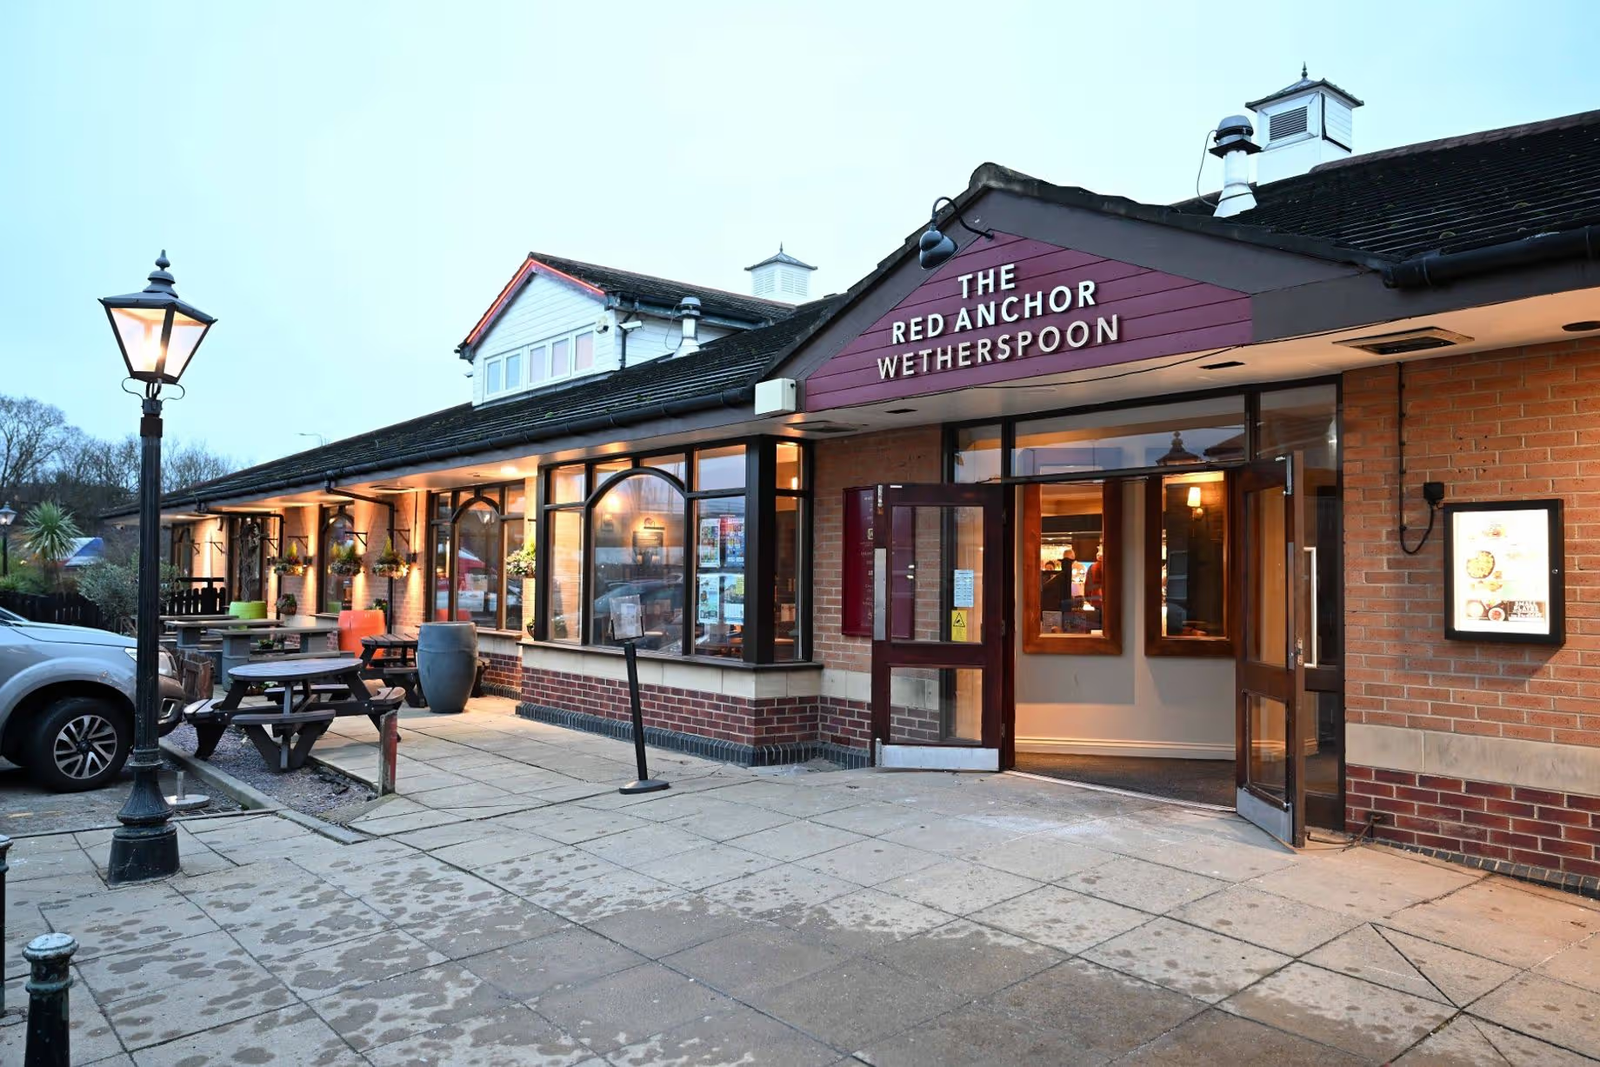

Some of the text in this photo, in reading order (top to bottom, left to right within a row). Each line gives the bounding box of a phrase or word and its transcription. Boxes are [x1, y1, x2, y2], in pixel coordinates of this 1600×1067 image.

[891, 280, 1096, 345] RED ANCHOR
[957, 263, 1016, 299] THE
[877, 313, 1119, 381] WETHERSPOON
